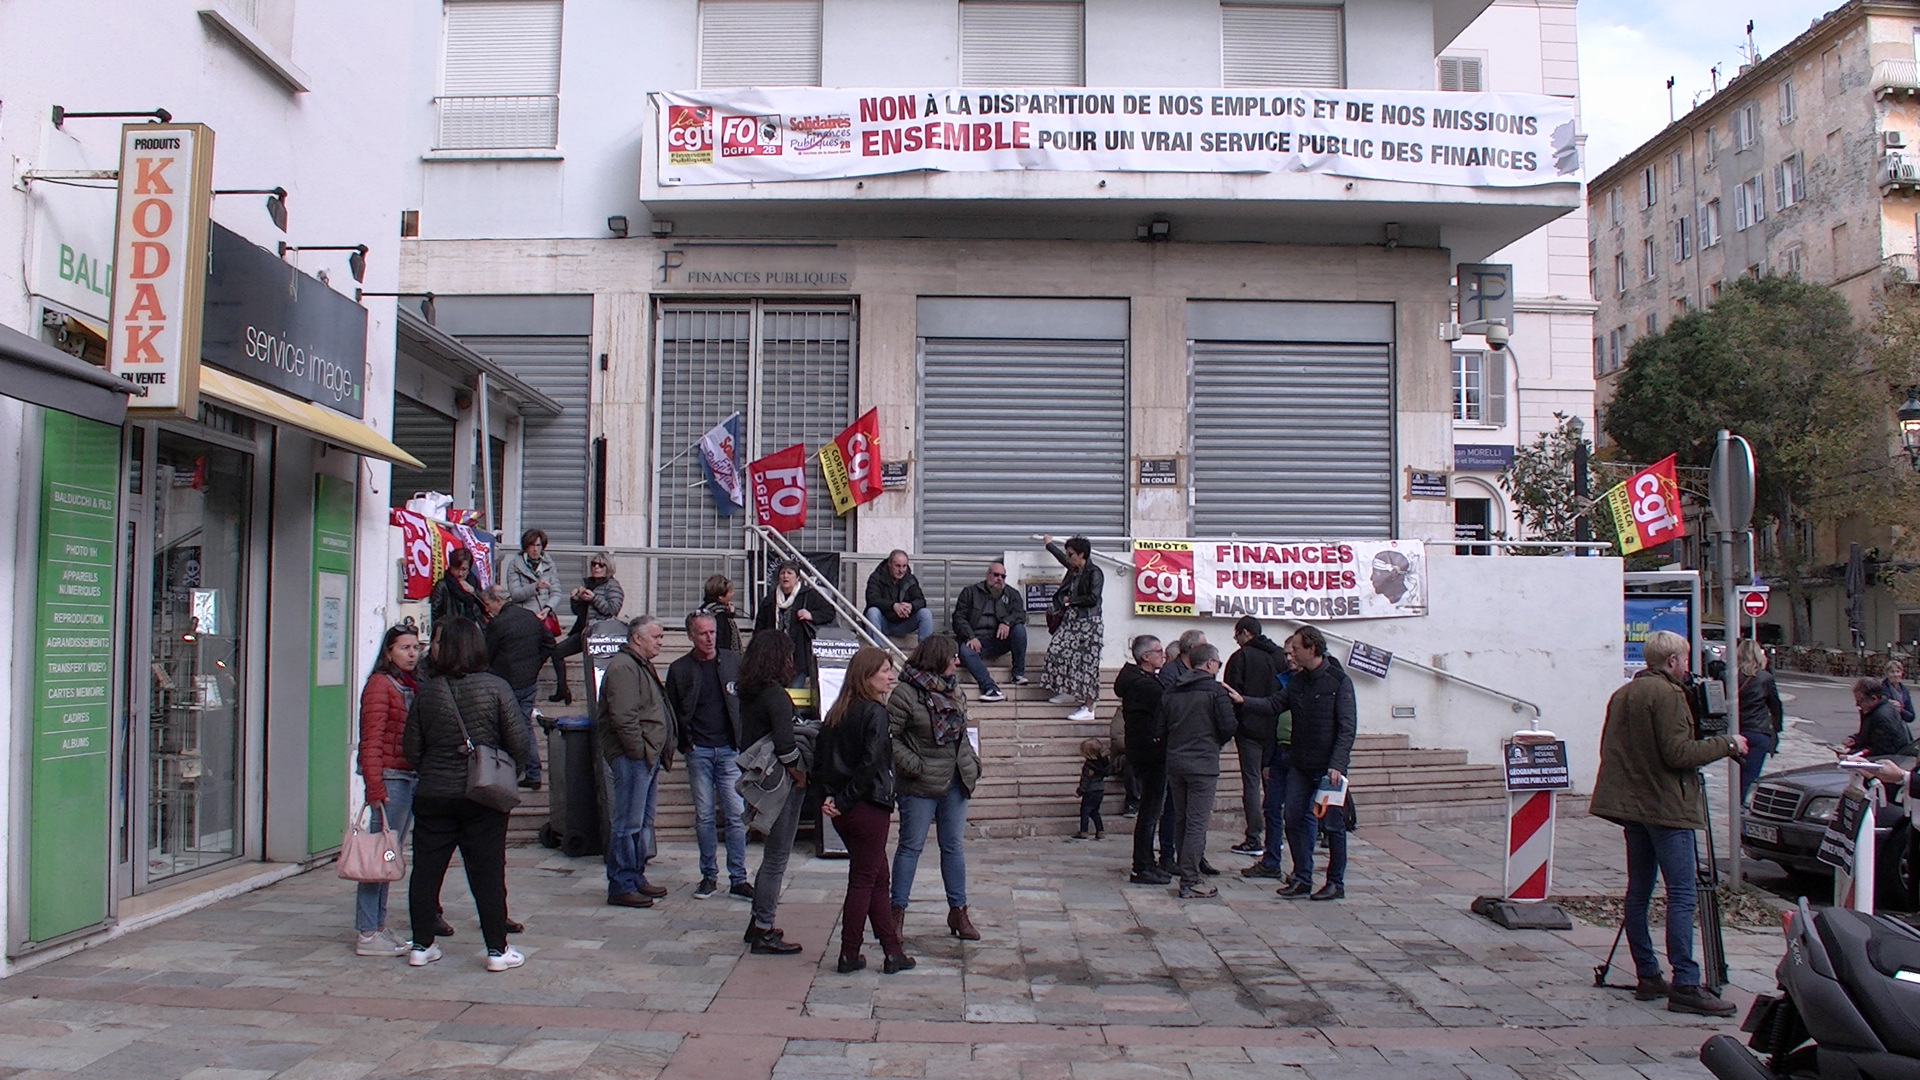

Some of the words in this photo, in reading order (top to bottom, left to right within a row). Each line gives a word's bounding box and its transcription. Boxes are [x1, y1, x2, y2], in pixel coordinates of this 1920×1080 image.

[860, 95, 917, 123] NON
[924, 93, 939, 118] À
[945, 95, 971, 115] LA
[979, 94, 1115, 115] DISPARITION
[1123, 95, 1151, 115] DE
[1159, 95, 1204, 116] NOS
[1211, 96, 1306, 118] EMPLOIS
[1313, 99, 1339, 120] ET
[1346, 102, 1374, 123] DE
[1381, 104, 1425, 127] NOS
[1432, 108, 1538, 136] MISSIONS
[723, 118, 755, 144] FO
[790, 115, 851, 131] Solidaires
[669, 121, 713, 150] cgt
[134, 138, 181, 150] PRODUITS
[723, 147, 755, 156] DGFIP
[762, 146, 777, 155] 2B
[840, 141, 851, 149] 2B
[862, 121, 1030, 157] ENSEMBLE
[1039, 130, 1097, 151] POUR
[1105, 130, 1135, 151] UN
[1141, 131, 1192, 152] VRAI
[1200, 131, 1291, 152] SERVICE
[1297, 134, 1374, 160] PUBLIC
[1381, 140, 1423, 164] DES
[1431, 144, 1538, 172] FINANCES
[123, 157, 175, 364] KODAK
[688, 271, 761, 284] FINANCES
[766, 271, 848, 286] PUBLIQUES
[245, 326, 306, 377] service
[308, 344, 352, 402] image
[136, 373, 166, 384] VENTE
[822, 449, 832, 469] TUTTI
[831, 449, 848, 489] CORSICA
[754, 471, 771, 521] DGFIP
[764, 466, 806, 516] FO
[54, 491, 92, 508] BALDUCCHI
[98, 498, 112, 511] FILS
[1633, 473, 1679, 537] cgt
[66, 544, 89, 557] PHOTO
[1139, 542, 1189, 550] IMPÔTS
[1216, 545, 1353, 564] FINANCES
[62, 570, 99, 583] APPAREILS
[1216, 570, 1357, 592] PUBLIQUES
[1136, 568, 1193, 602] cgt
[1139, 604, 1192, 613] TRESOR
[1215, 595, 1360, 616] HAUTE-CORSE
[53, 612, 104, 625] REPRODUCTION
[46, 637, 110, 648] AGRANDISSEMENTS
[589, 645, 620, 654] SACRIF
[48, 662, 87, 674] TRANSFERT
[48, 688, 75, 699] CARTES
[75, 686, 105, 698] MEMOIRE
[63, 712, 90, 724] CADRES
[62, 737, 90, 750] ALBUMS
